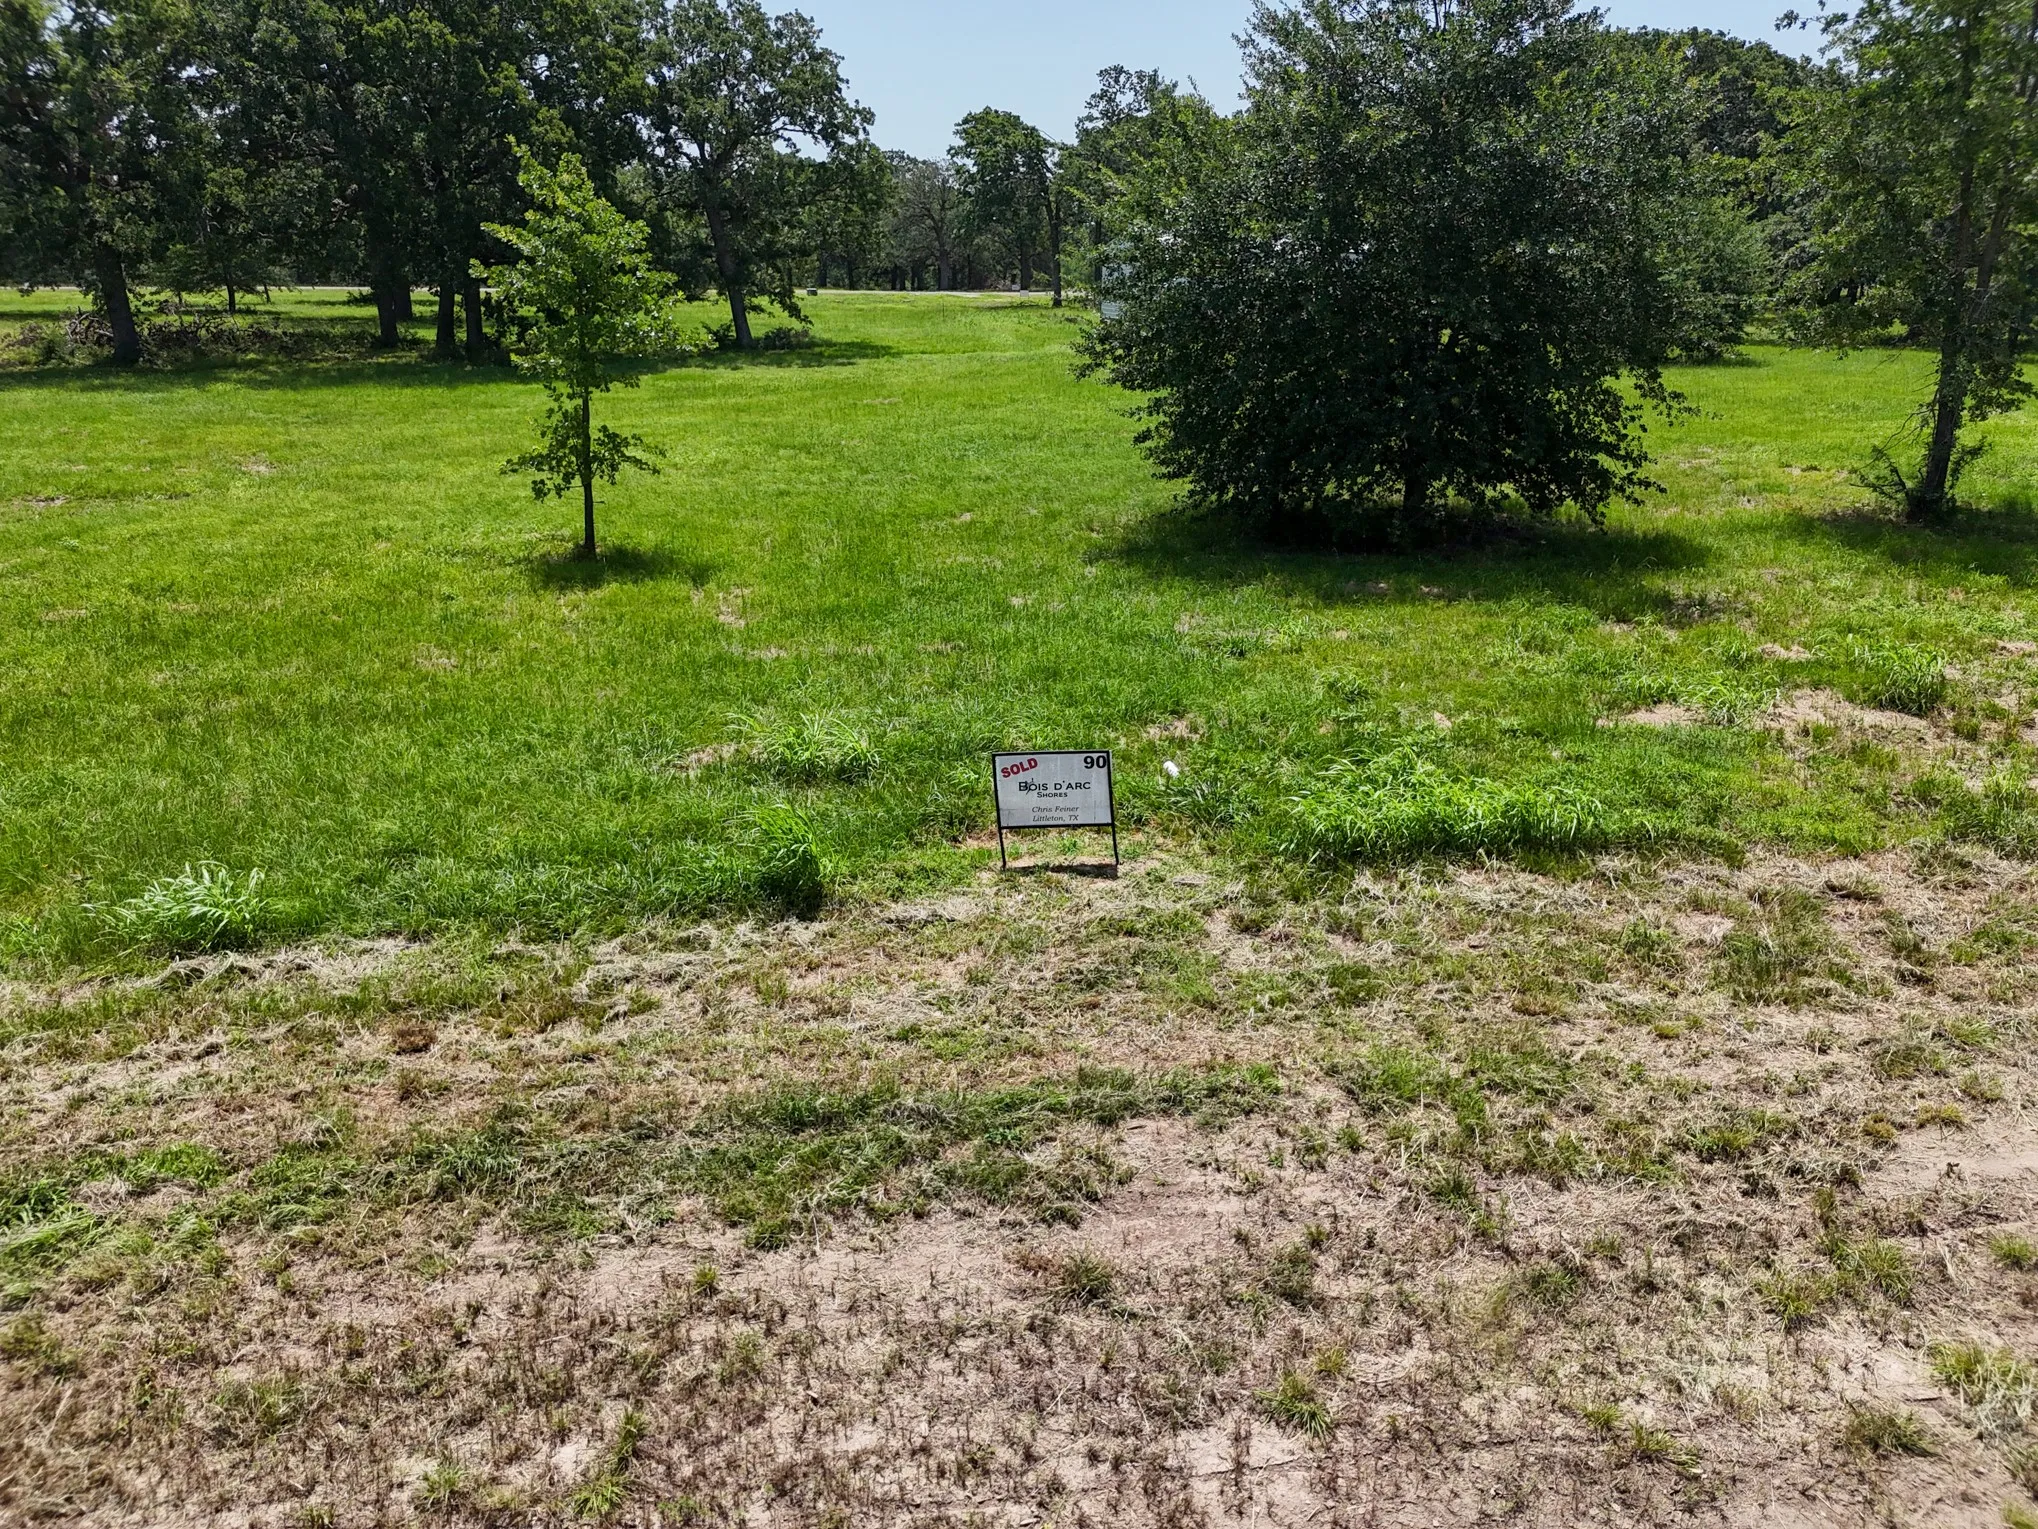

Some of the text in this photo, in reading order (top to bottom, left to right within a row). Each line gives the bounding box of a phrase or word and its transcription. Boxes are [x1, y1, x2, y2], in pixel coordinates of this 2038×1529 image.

[1001, 757, 1038, 778] SOLD
[1083, 755, 1107, 769] 90
[1054, 780, 1091, 790] D'ARC
